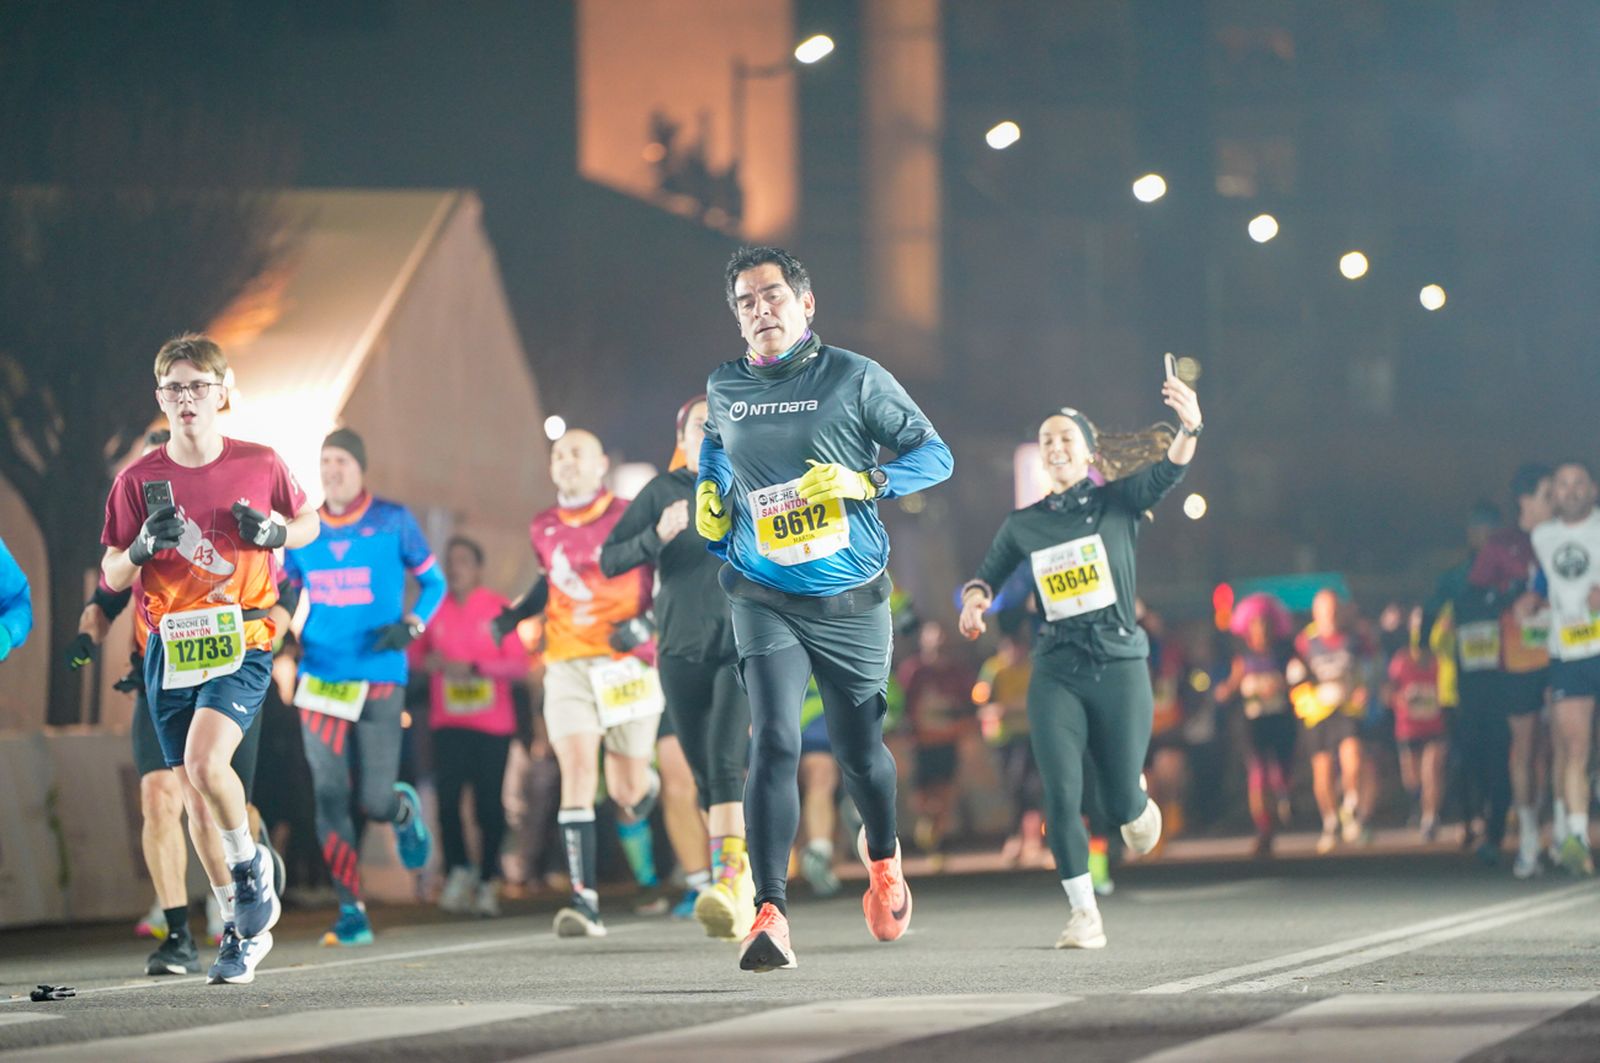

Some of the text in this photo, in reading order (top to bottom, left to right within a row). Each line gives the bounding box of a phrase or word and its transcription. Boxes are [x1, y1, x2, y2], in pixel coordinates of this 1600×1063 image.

[749, 403, 779, 416] NTT
[761, 504, 779, 518] SAN
[772, 504, 829, 540] 9612
[192, 545, 214, 566] 43
[1046, 564, 1099, 595] 13644
[176, 619, 198, 629] NOCHE
[200, 617, 209, 626] DE
[169, 631, 185, 640] SAN
[175, 635, 233, 663] 12733
